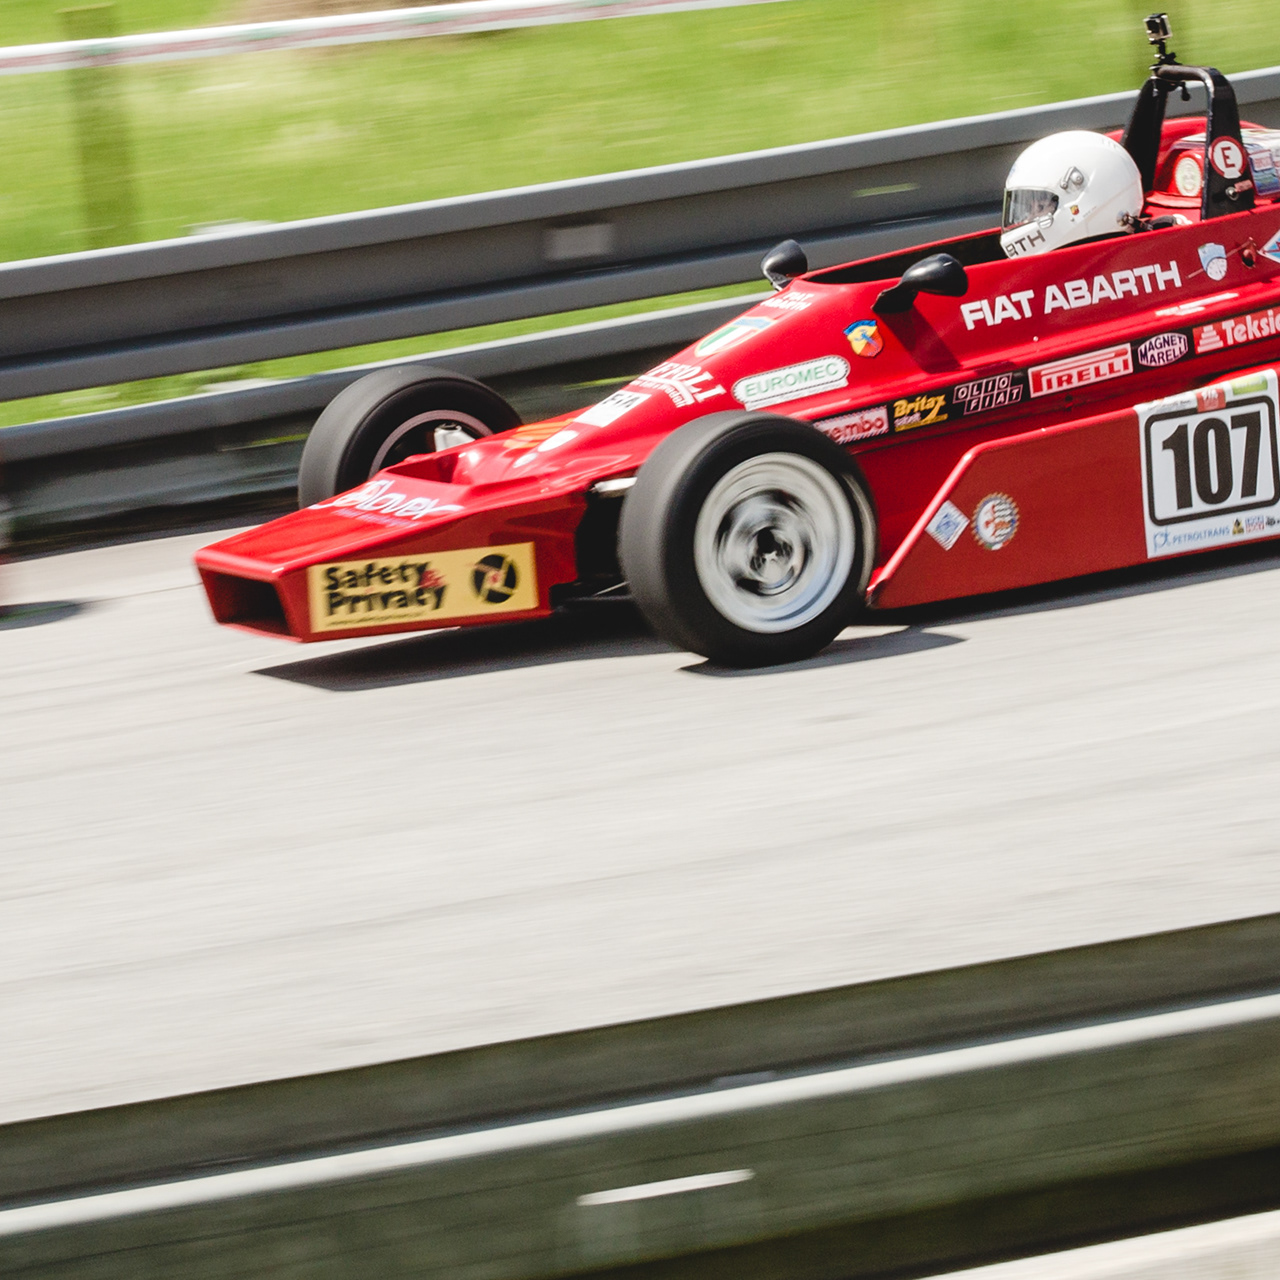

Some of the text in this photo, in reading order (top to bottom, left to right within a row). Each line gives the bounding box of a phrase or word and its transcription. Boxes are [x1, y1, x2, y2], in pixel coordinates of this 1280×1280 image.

[1221, 147, 1236, 168] E
[960, 260, 1183, 331] FIAT ABARTH
[1140, 335, 1187, 362] MAGNETI
[745, 362, 839, 398] EUROMEC
[1031, 348, 1129, 394] PIRELLI
[957, 376, 1009, 400] OLIO
[969, 388, 1020, 411] FIAT
[893, 394, 947, 421] Britax
[1162, 410, 1262, 511] 107
[325, 561, 430, 591] Safety
[326, 585, 447, 617] Privacy
